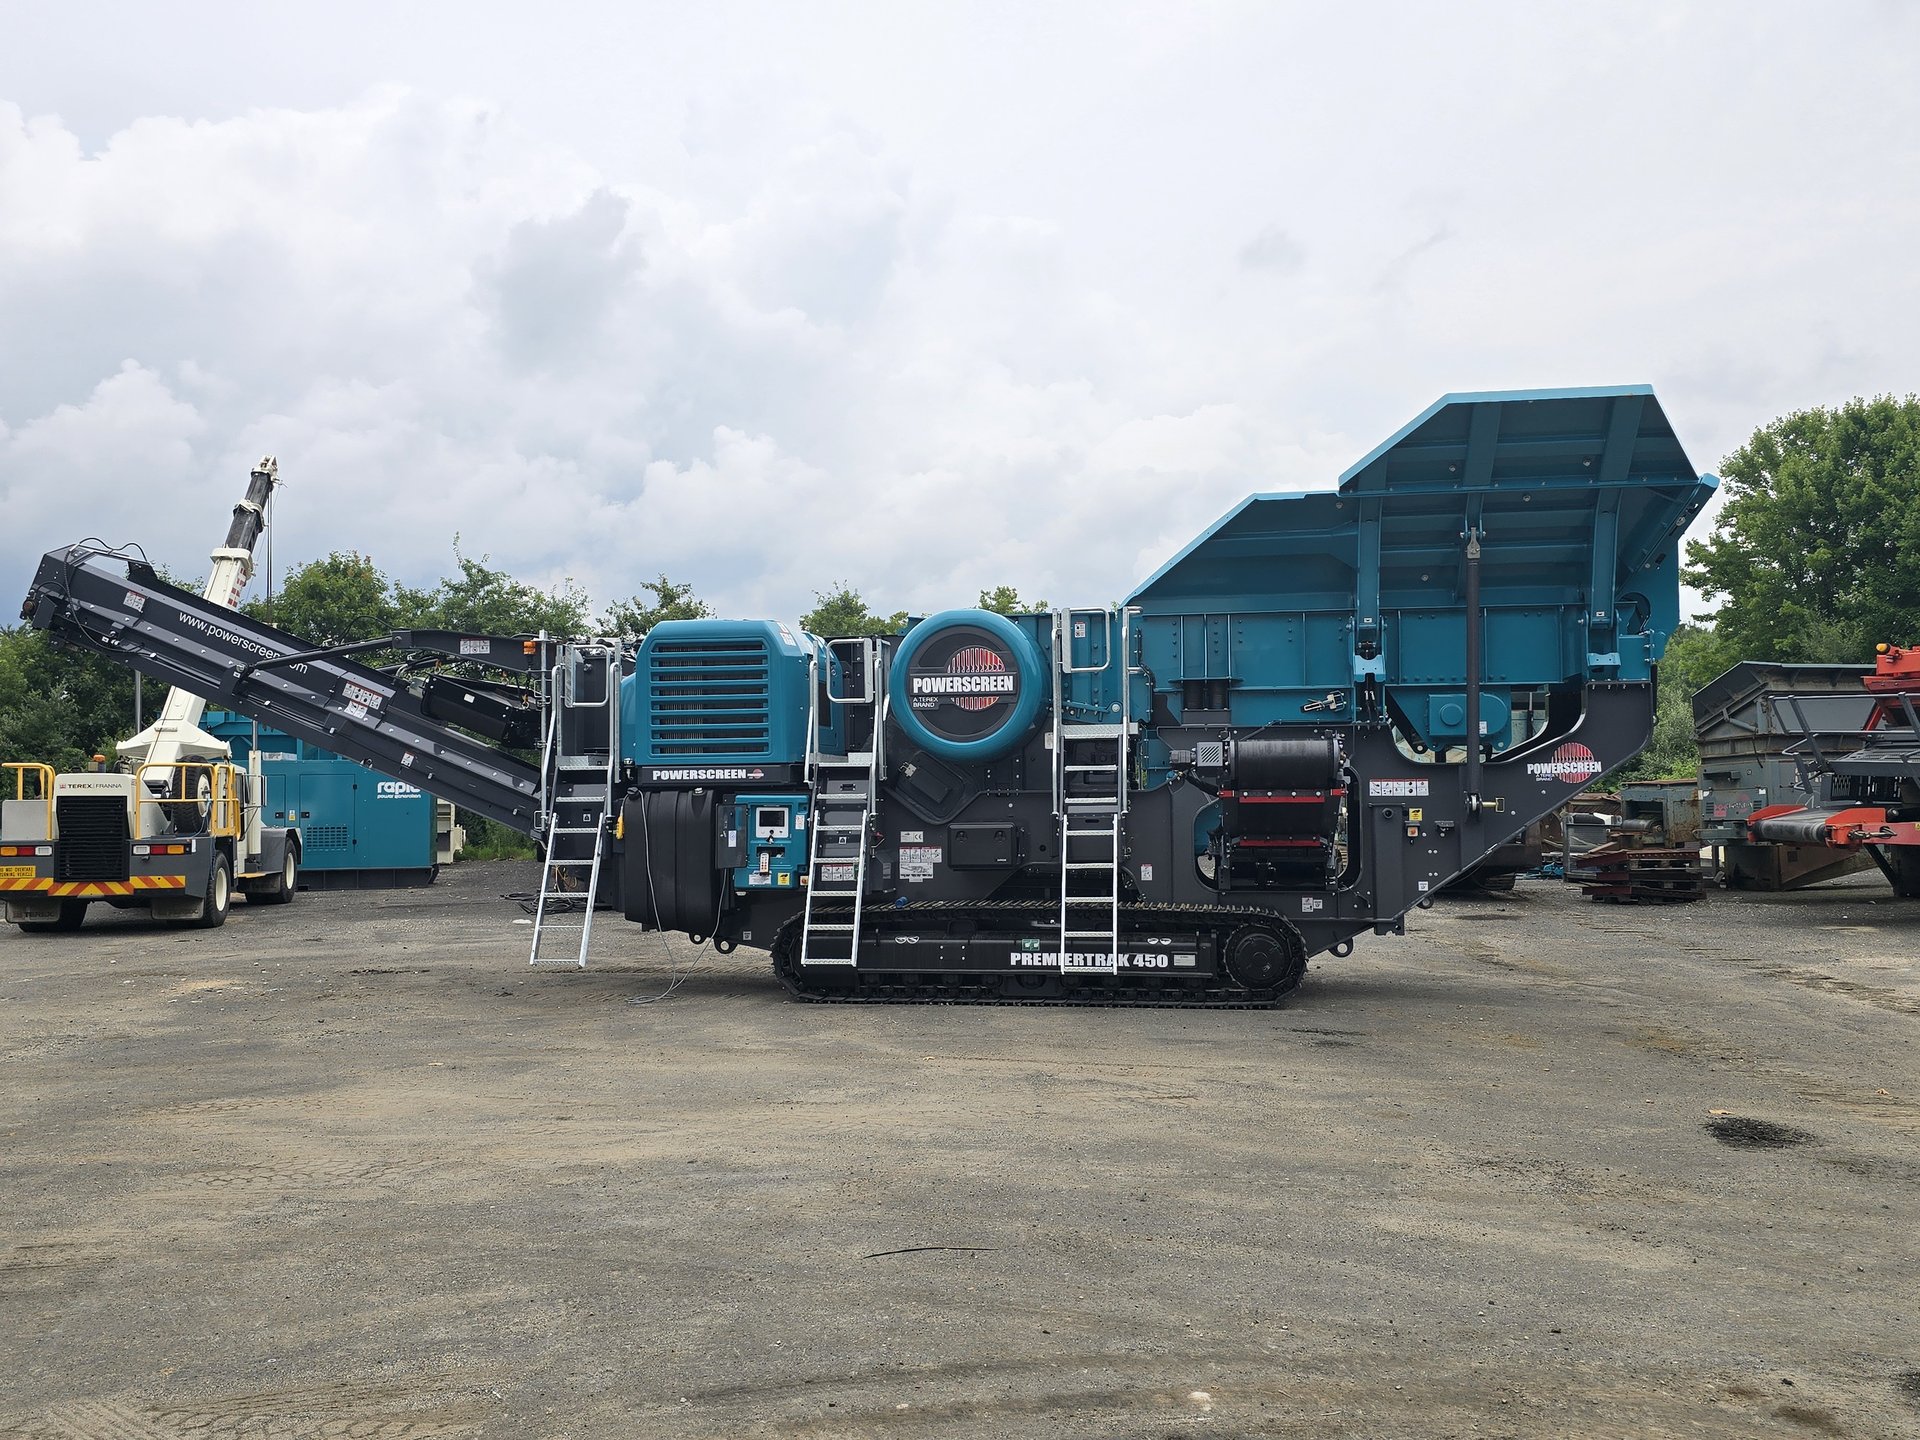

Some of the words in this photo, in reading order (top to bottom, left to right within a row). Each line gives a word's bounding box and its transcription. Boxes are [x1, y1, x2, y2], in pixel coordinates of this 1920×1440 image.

[179, 612, 308, 674] www.powerscreenom
[912, 676, 1014, 693] POWERSCREEN
[652, 769, 746, 780] POWERSCREEN
[1527, 761, 1602, 774] POWERSCREEN
[1010, 953, 1130, 967] PREMIERTRAK
[1132, 954, 1168, 967] 450
